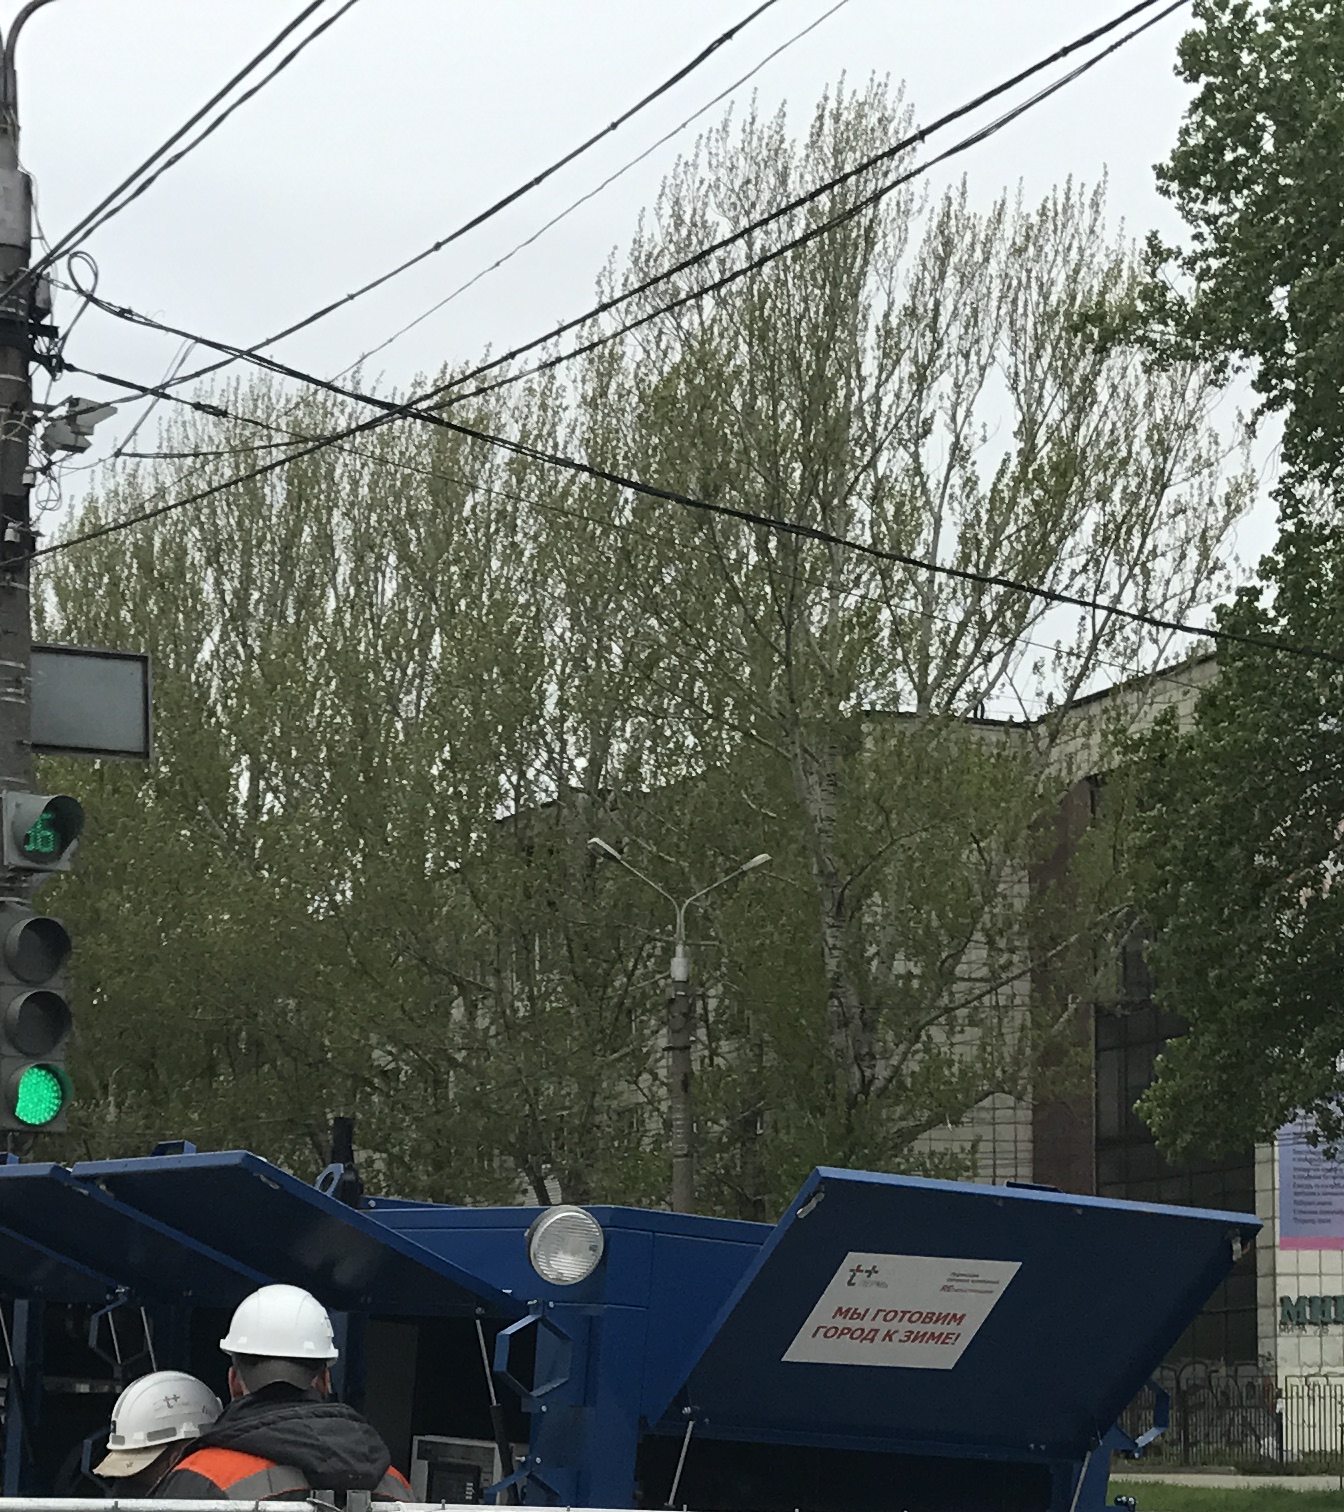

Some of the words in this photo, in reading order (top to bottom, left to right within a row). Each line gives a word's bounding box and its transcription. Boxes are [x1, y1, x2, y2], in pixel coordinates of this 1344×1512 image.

[832, 1306, 870, 1322] МЫ
[871, 1308, 966, 1327] ГОТОВИМ
[811, 1325, 879, 1343] ГОРОД
[881, 1329, 895, 1343] К
[898, 1330, 961, 1345] ЗИМЕ!
